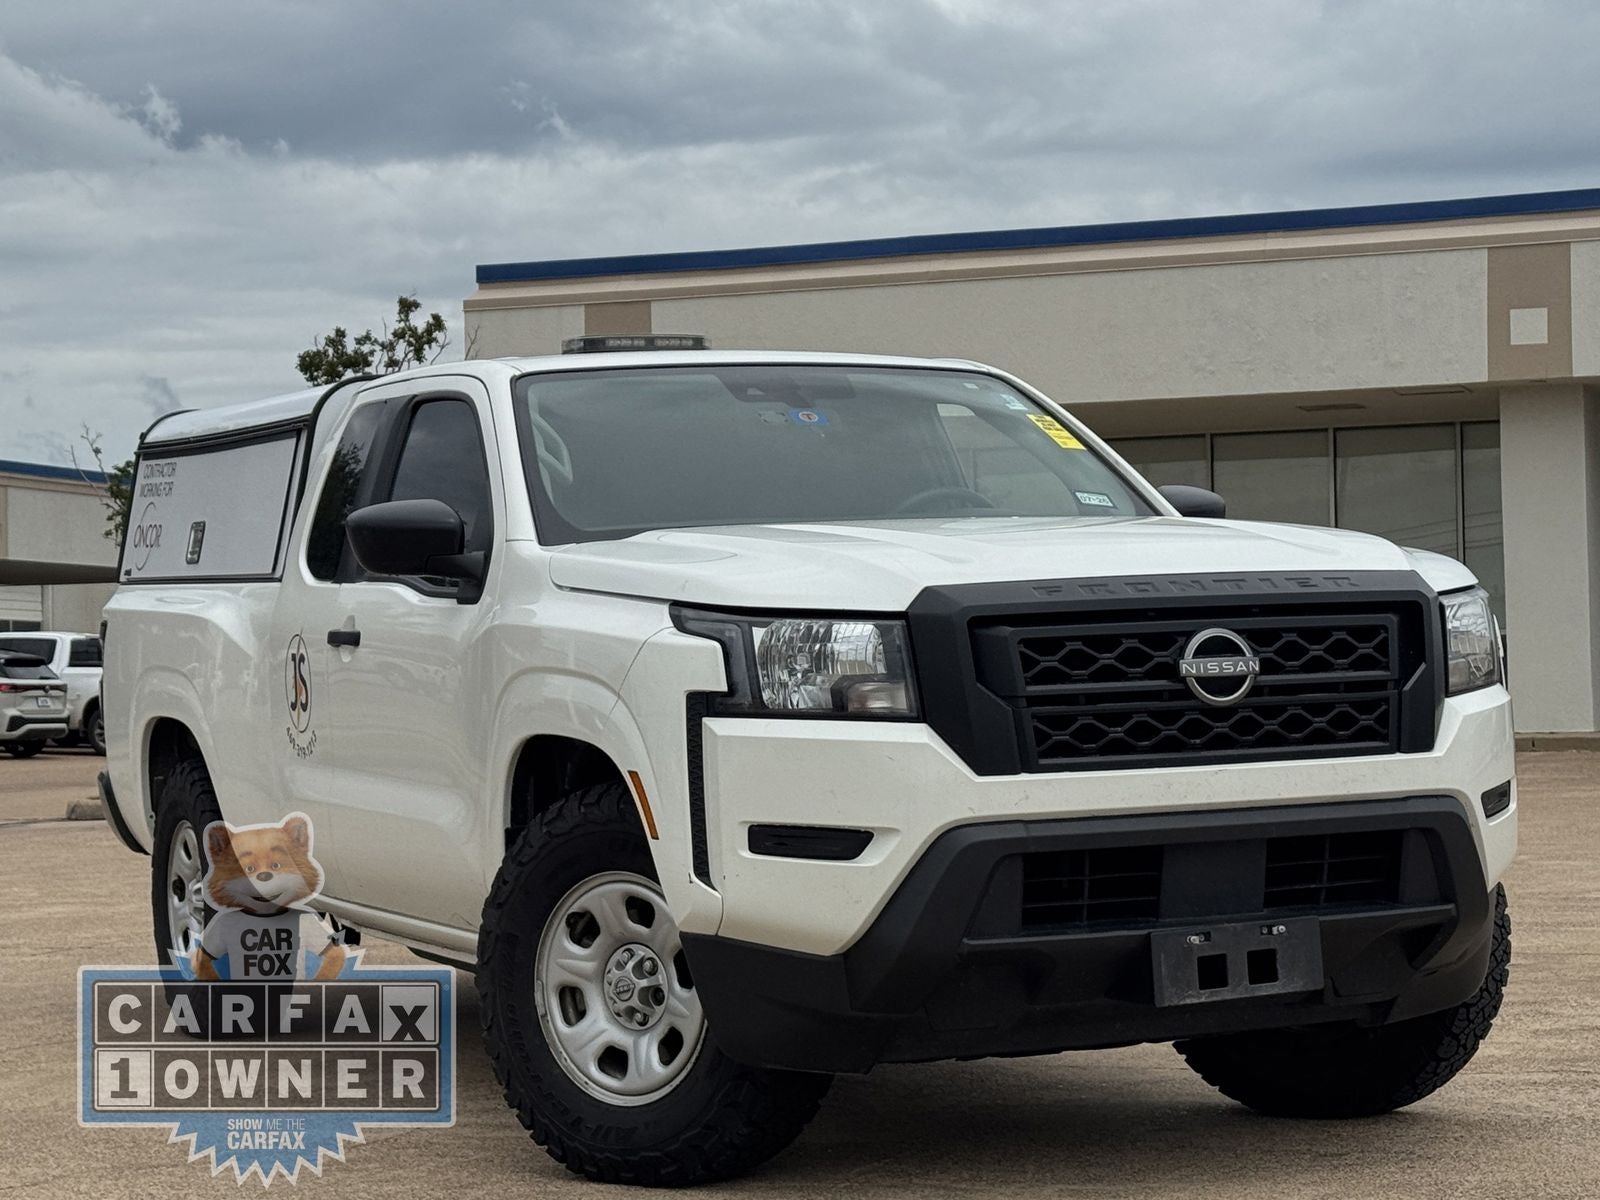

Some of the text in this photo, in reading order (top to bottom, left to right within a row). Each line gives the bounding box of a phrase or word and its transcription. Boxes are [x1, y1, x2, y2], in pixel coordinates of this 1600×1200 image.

[143, 462, 177, 479] CONTRACTOR
[162, 481, 174, 497] FOR
[133, 524, 163, 548] ONCOR
[1032, 576, 1361, 597] FRONTIER
[1181, 659, 1260, 675] NISSAN
[290, 652, 309, 712] JS
